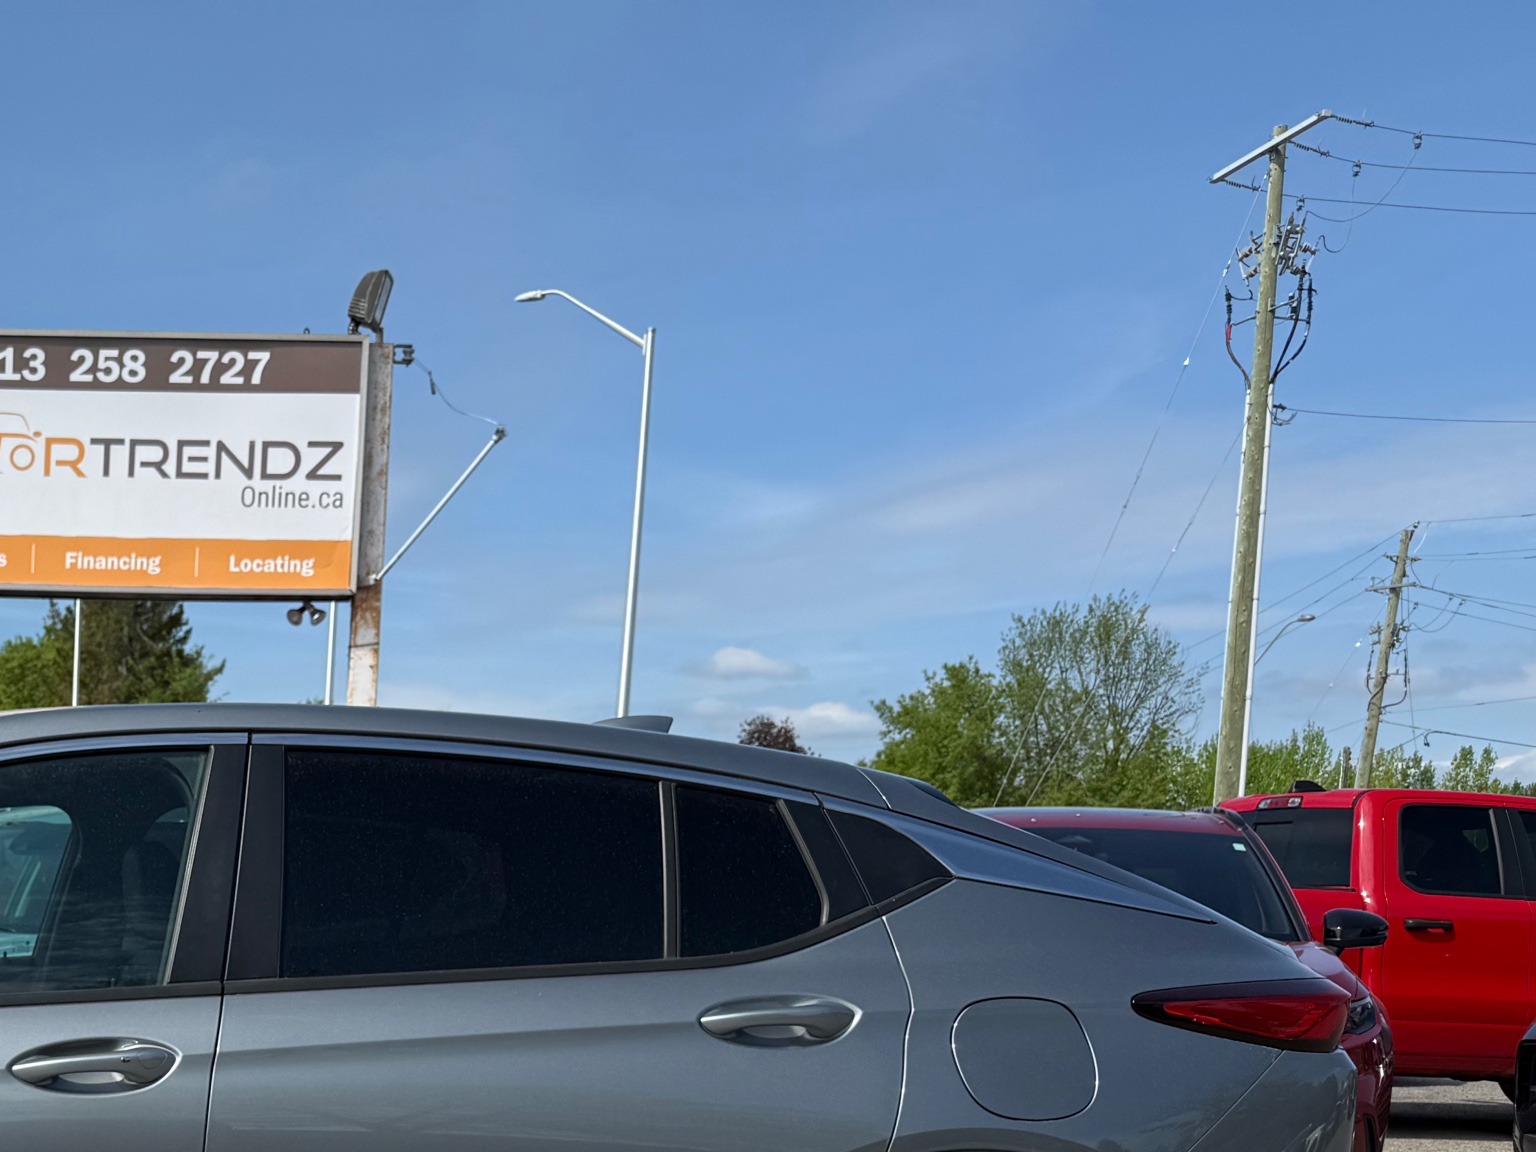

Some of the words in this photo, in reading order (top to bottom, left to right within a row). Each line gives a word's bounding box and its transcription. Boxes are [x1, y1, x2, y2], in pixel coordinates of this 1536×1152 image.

[69, 349, 146, 383] 258
[168, 350, 271, 385] 2727
[240, 485, 344, 509] Online.ca
[64, 551, 161, 575] Financing
[228, 555, 315, 577] Locating
